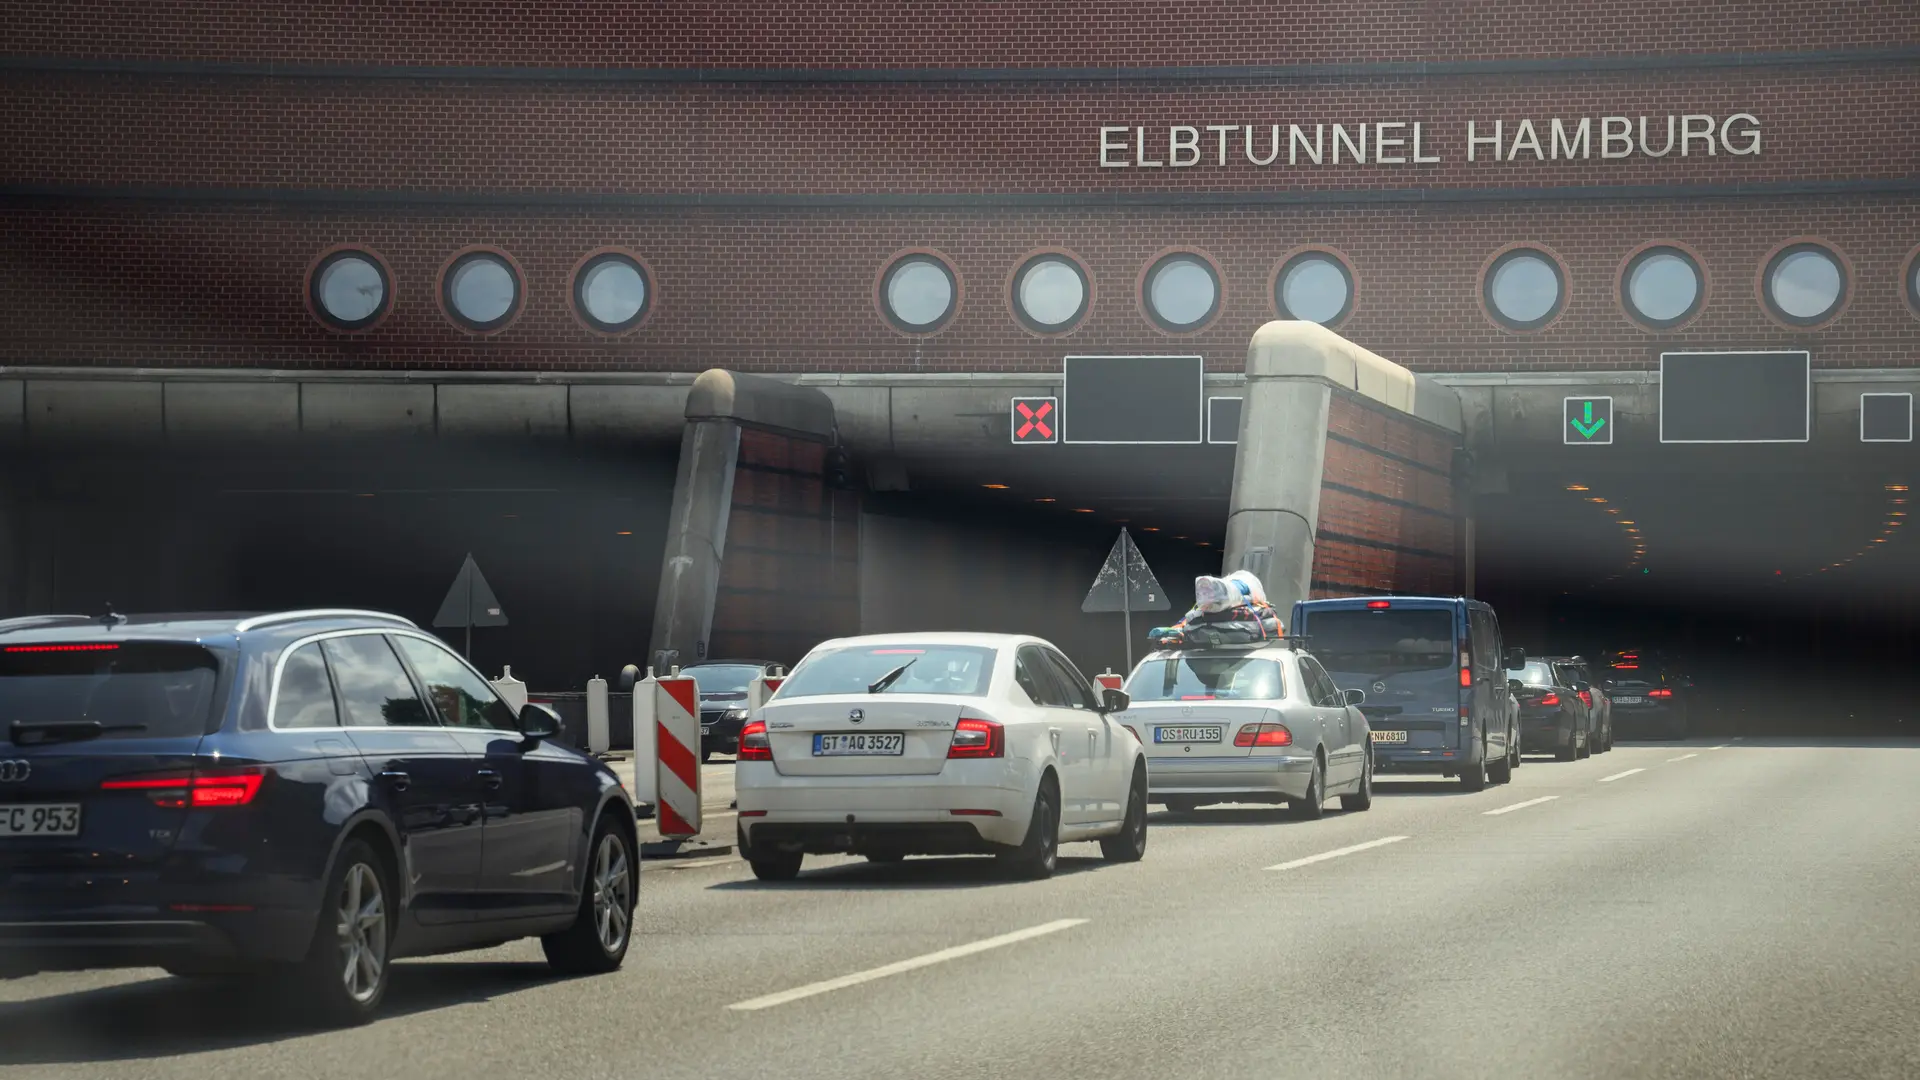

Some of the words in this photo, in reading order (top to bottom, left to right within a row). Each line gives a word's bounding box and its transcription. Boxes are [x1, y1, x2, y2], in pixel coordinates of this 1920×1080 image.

[1100, 122, 1440, 167] ELBTUNNEL
[1467, 112, 1762, 161] HAMBURG
[1162, 729, 1176, 740] OS
[1182, 729, 1197, 740] RU
[1199, 728, 1219, 740] 155
[1386, 732, 1405, 741] 6810
[822, 736, 839, 750] GT
[849, 736, 865, 750] AQ
[868, 735, 901, 750] 3527
[32, 807, 78, 832] 953
